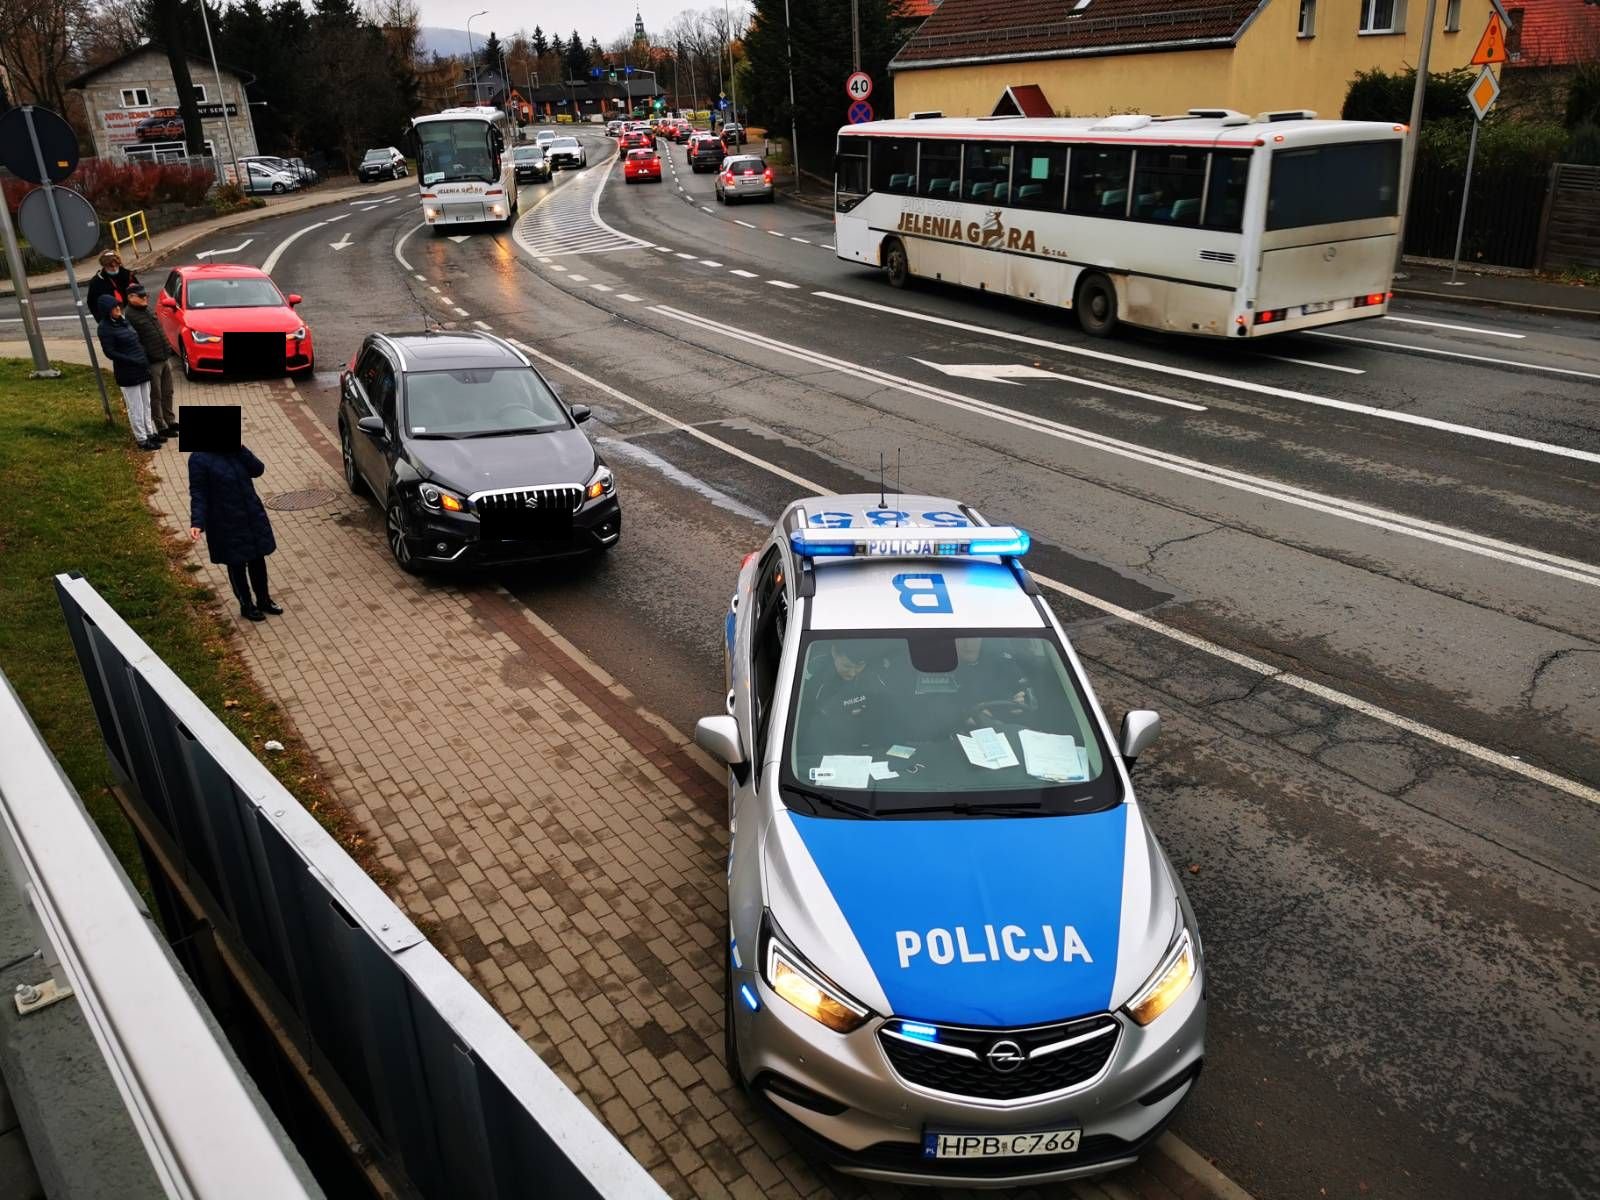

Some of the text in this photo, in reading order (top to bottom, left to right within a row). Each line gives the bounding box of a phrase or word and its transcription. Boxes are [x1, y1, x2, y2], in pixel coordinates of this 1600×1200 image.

[851, 79, 869, 93] 40
[897, 212, 963, 241] JELENIA
[967, 210, 1036, 252] GRA
[869, 541, 933, 555] POLICJA
[891, 573, 954, 614] B
[895, 924, 1094, 968] POLICJA
[925, 1131, 1076, 1156] PL HPB C766
